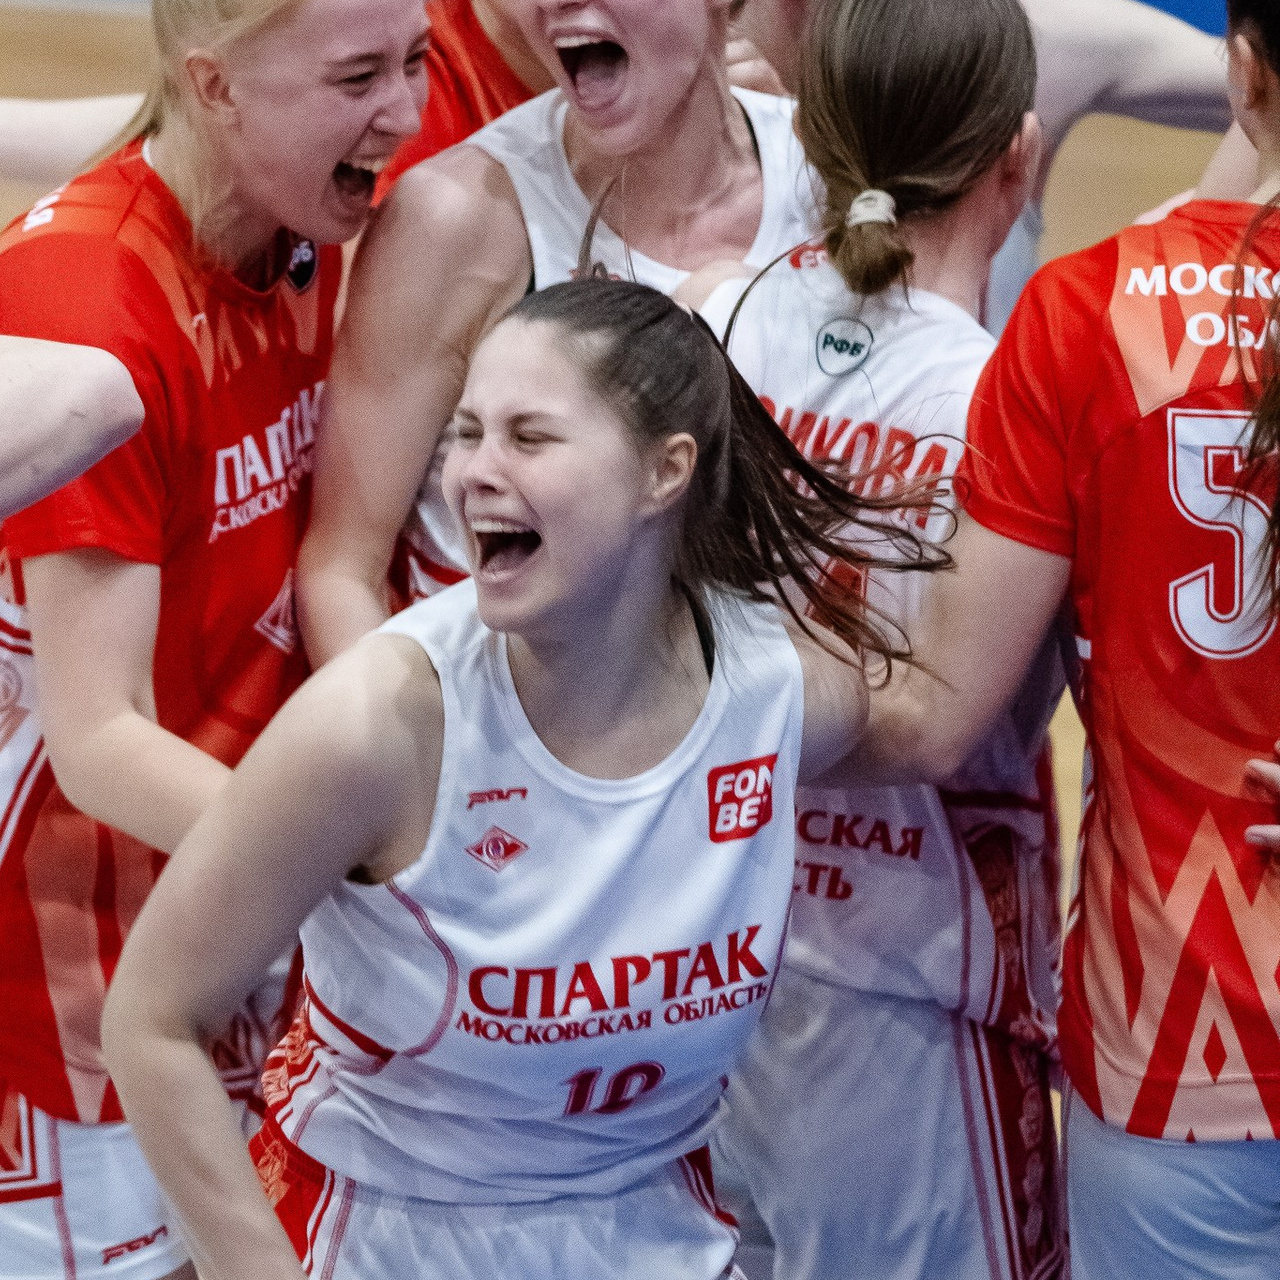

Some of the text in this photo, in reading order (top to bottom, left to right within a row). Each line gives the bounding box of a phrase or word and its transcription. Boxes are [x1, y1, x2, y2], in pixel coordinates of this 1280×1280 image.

[1167, 407, 1280, 660] 5
[715, 794, 768, 833] BE
[468, 924, 769, 1019] СПАРТАК
[456, 981, 768, 1046] МОСКОВСКАЯ ОБЛАСТЬ
[560, 1061, 666, 1117] 10
